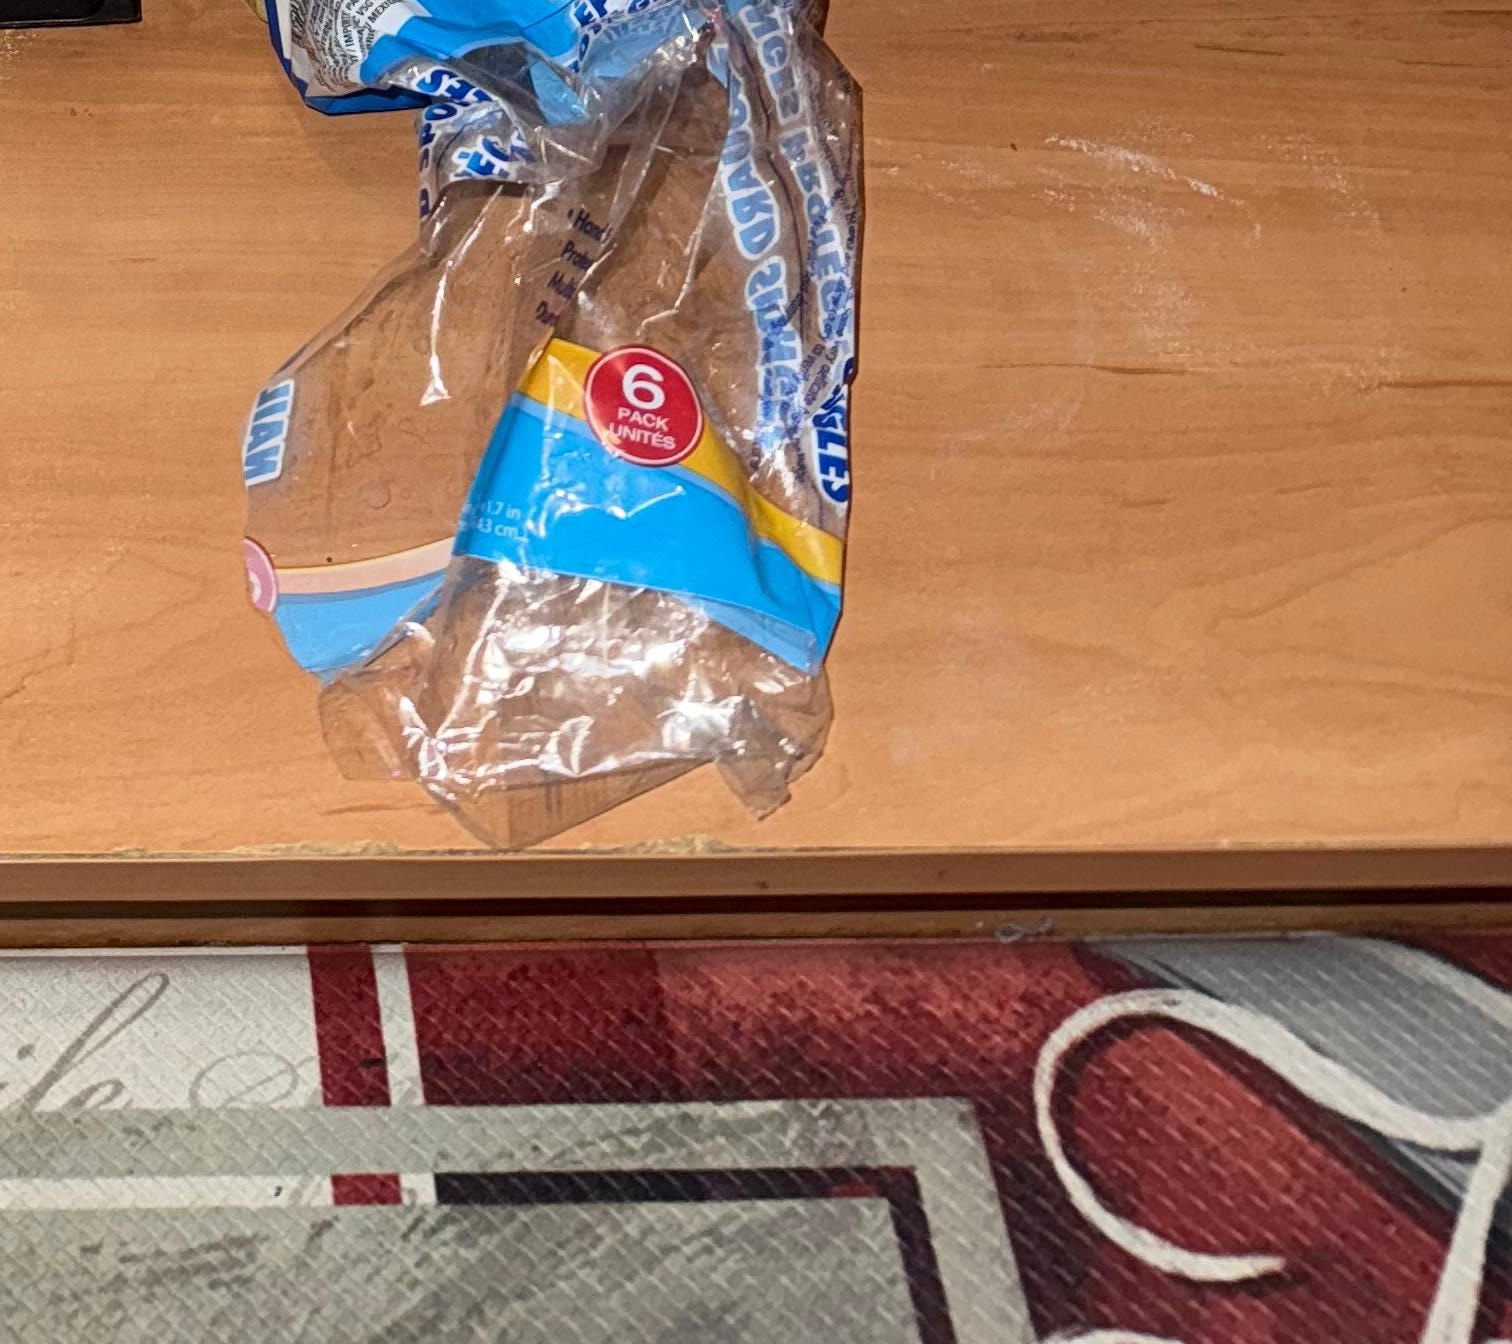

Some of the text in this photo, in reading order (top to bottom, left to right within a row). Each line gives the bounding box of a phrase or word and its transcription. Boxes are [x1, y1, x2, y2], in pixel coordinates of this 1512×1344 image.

[622, 364, 665, 410] 6
[617, 406, 670, 431] PACK
[609, 422, 677, 450] UNITÉS
